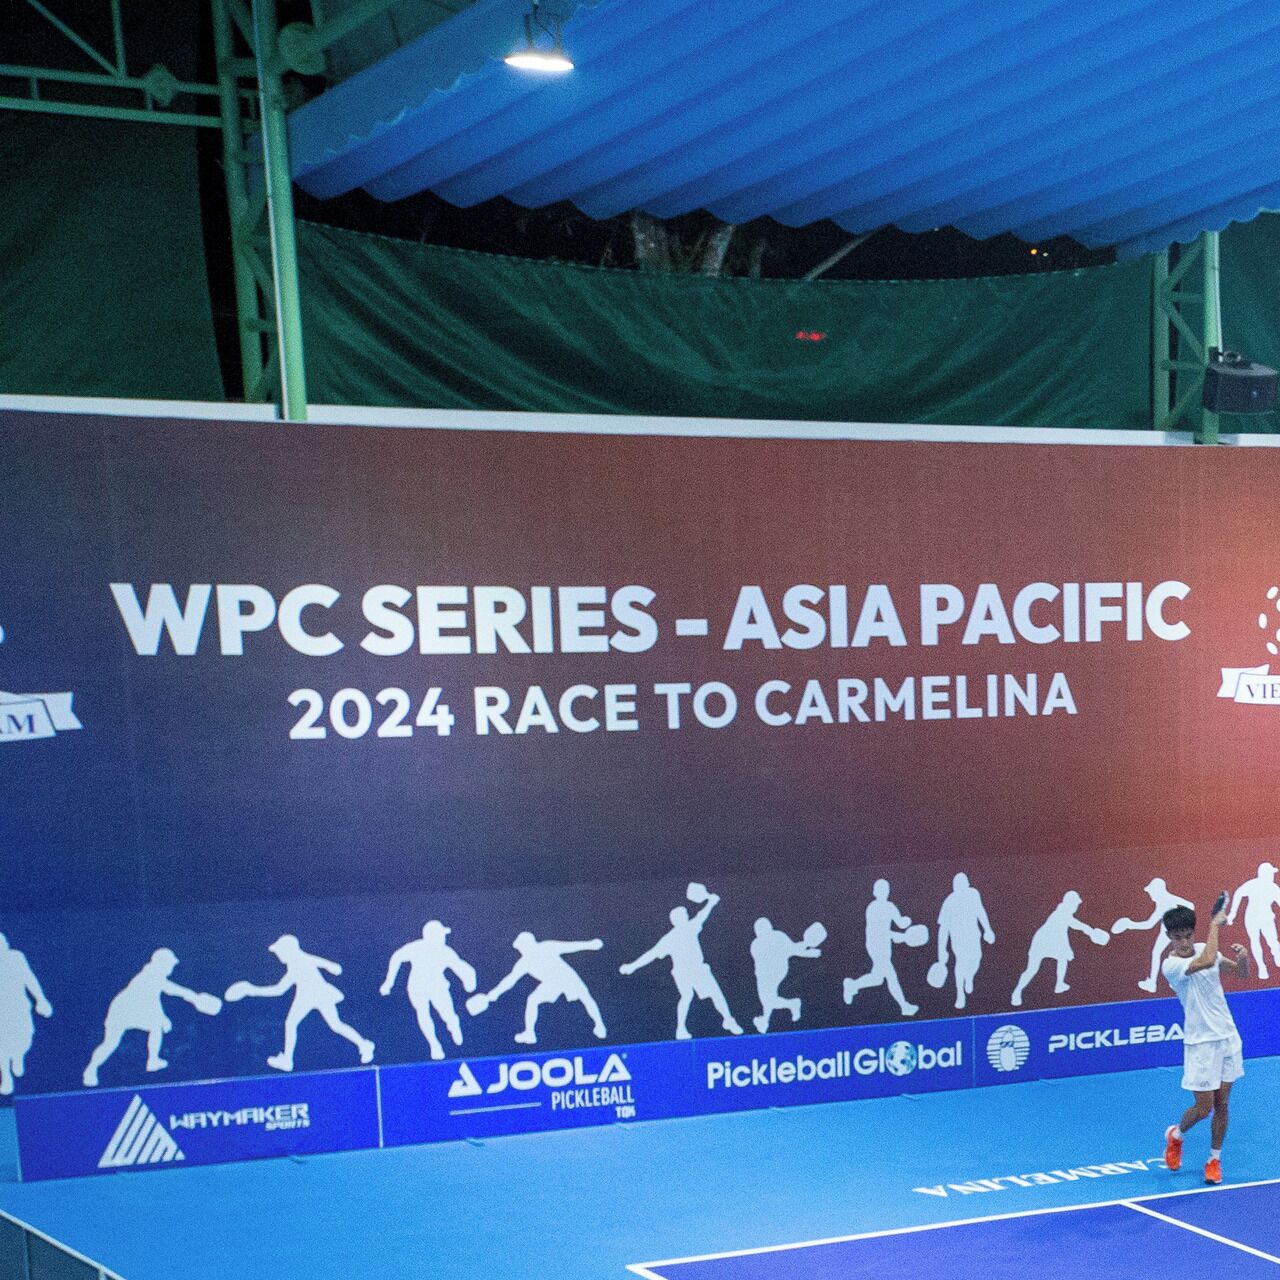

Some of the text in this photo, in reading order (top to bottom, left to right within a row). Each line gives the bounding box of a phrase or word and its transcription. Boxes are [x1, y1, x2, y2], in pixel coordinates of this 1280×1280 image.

[110, 583, 344, 656] WPC
[360, 584, 659, 656] SERIES
[723, 584, 907, 650] ASIA
[920, 580, 1192, 645] PACIFIC
[287, 672, 1078, 740] 2024 RACE TO CARMELINA
[486, 1053, 632, 1094] JOOLA
[707, 1051, 850, 1089] Pickleball
[169, 1103, 310, 1131] WAYMAKER
[551, 1085, 635, 1111] PICKLEBALL
